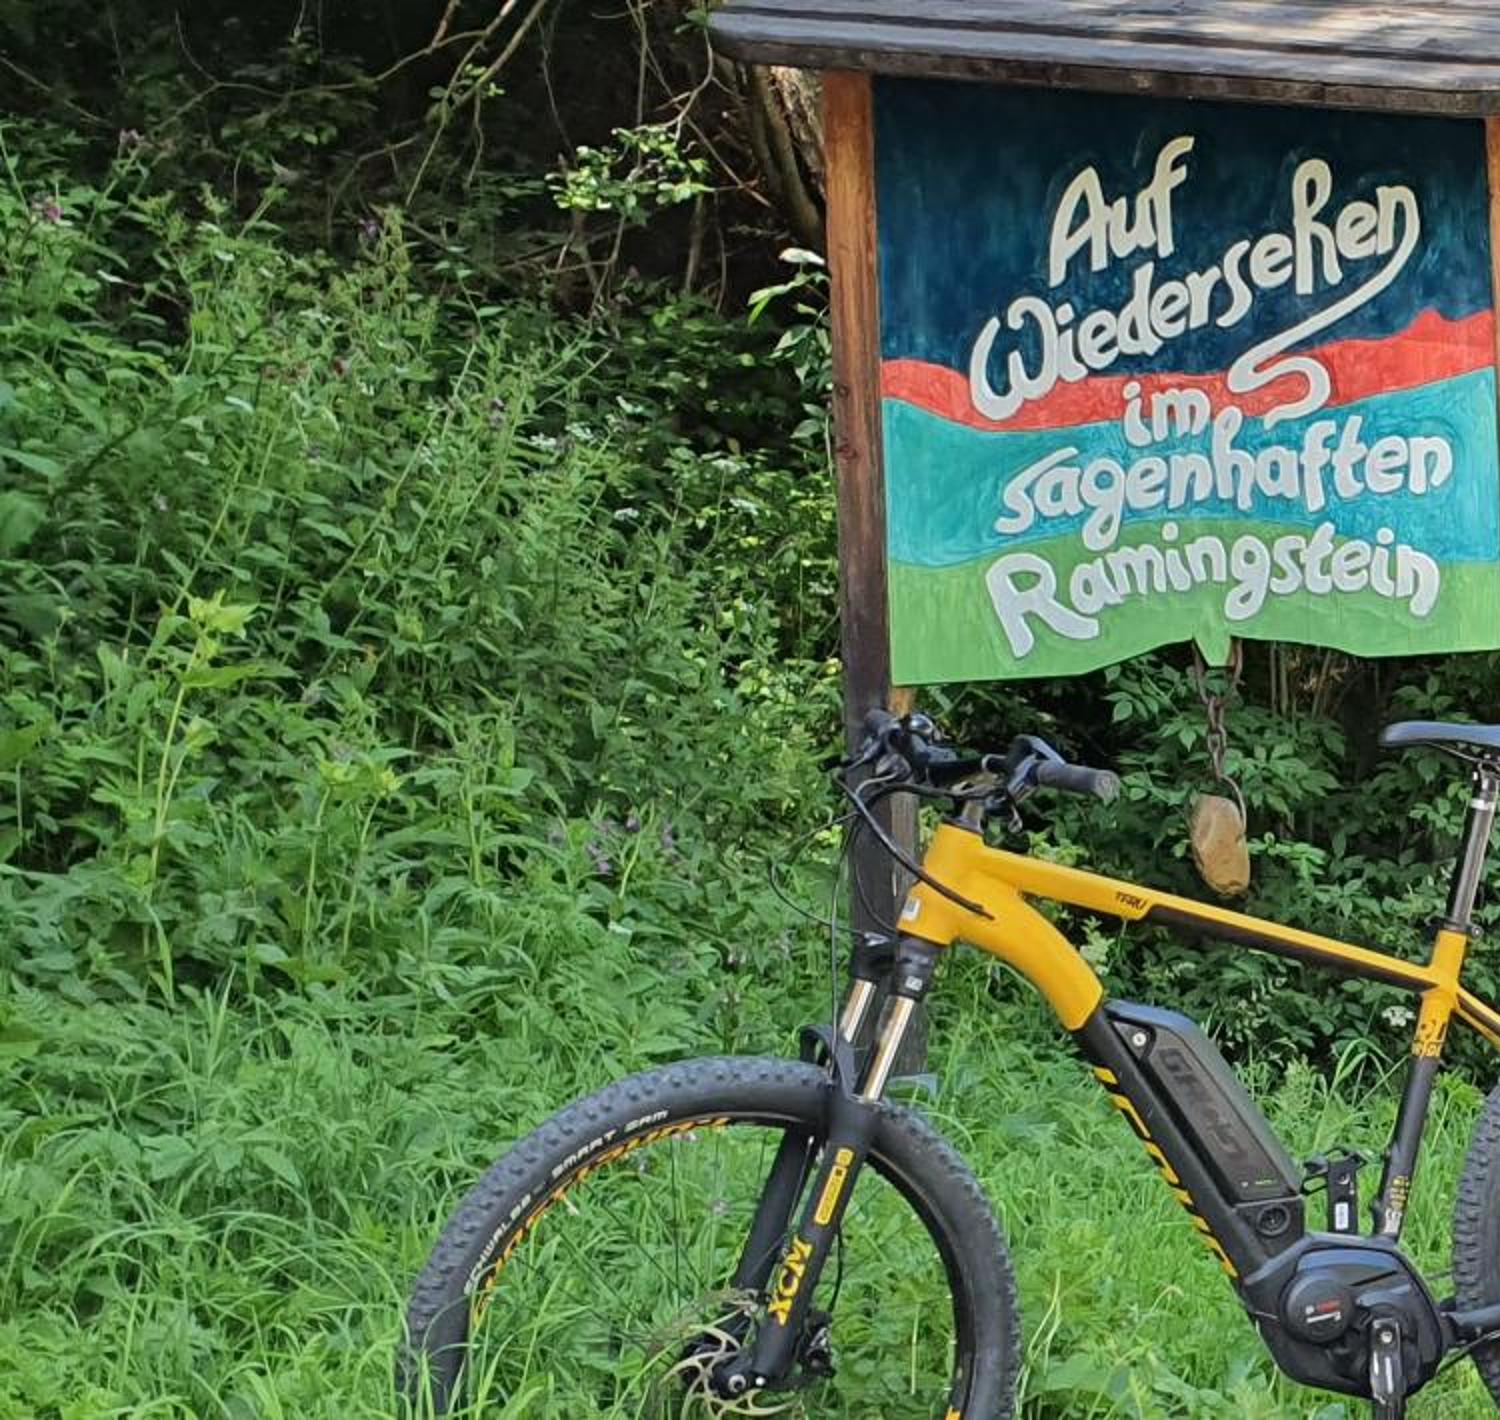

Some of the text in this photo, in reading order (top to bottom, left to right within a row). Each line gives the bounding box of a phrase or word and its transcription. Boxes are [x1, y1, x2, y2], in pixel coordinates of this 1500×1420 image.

[1047, 135, 1195, 289] Auf
[968, 157, 1421, 429] Wiedersehen
[994, 408, 1454, 551] sagenhaften
[1122, 382, 1211, 448] im
[984, 522, 1442, 659] Ramingstein
[767, 1233, 814, 1327] XCM
